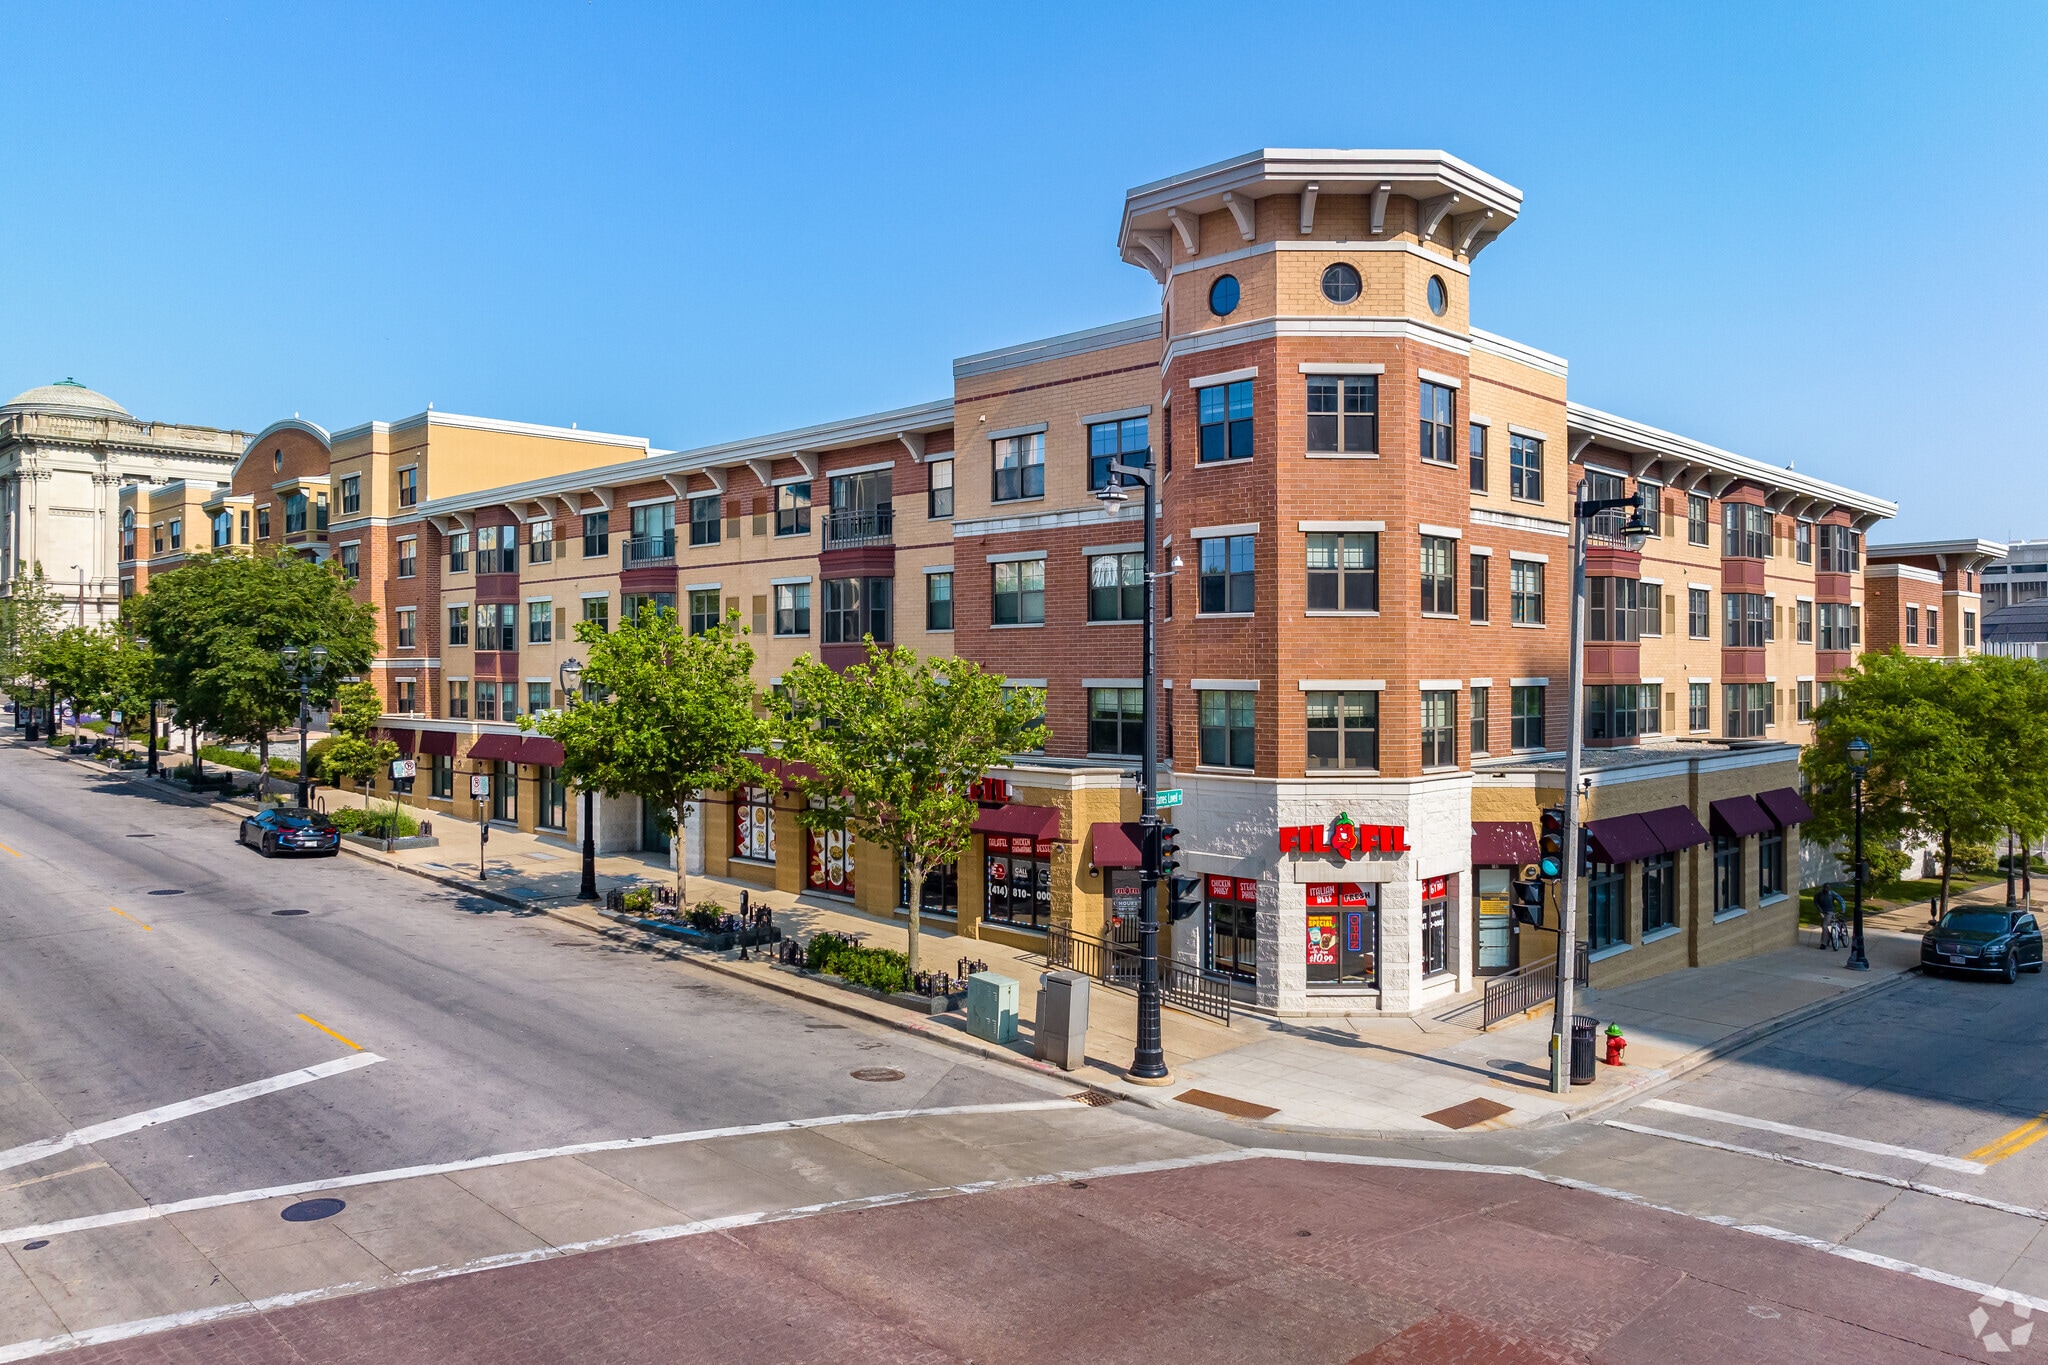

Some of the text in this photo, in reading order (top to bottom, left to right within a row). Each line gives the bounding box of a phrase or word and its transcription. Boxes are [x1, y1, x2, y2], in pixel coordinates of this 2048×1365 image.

[1012, 838, 1031, 846] CHICKEN
[1279, 824, 1411, 853] FIL FIL
[1036, 844, 1051, 853] DESSE
[1014, 867, 1028, 875] CALL
[1211, 880, 1231, 888] CHICKEN
[988, 884, 1008, 898] (414)
[1036, 891, 1052, 901] 000
[1309, 885, 1335, 897] ITALIAN
[1316, 894, 1333, 904] BEEF
[1344, 891, 1371, 902] FRESH
[1350, 916, 1359, 949] OPEN
[1309, 954, 1334, 963] $10.99
